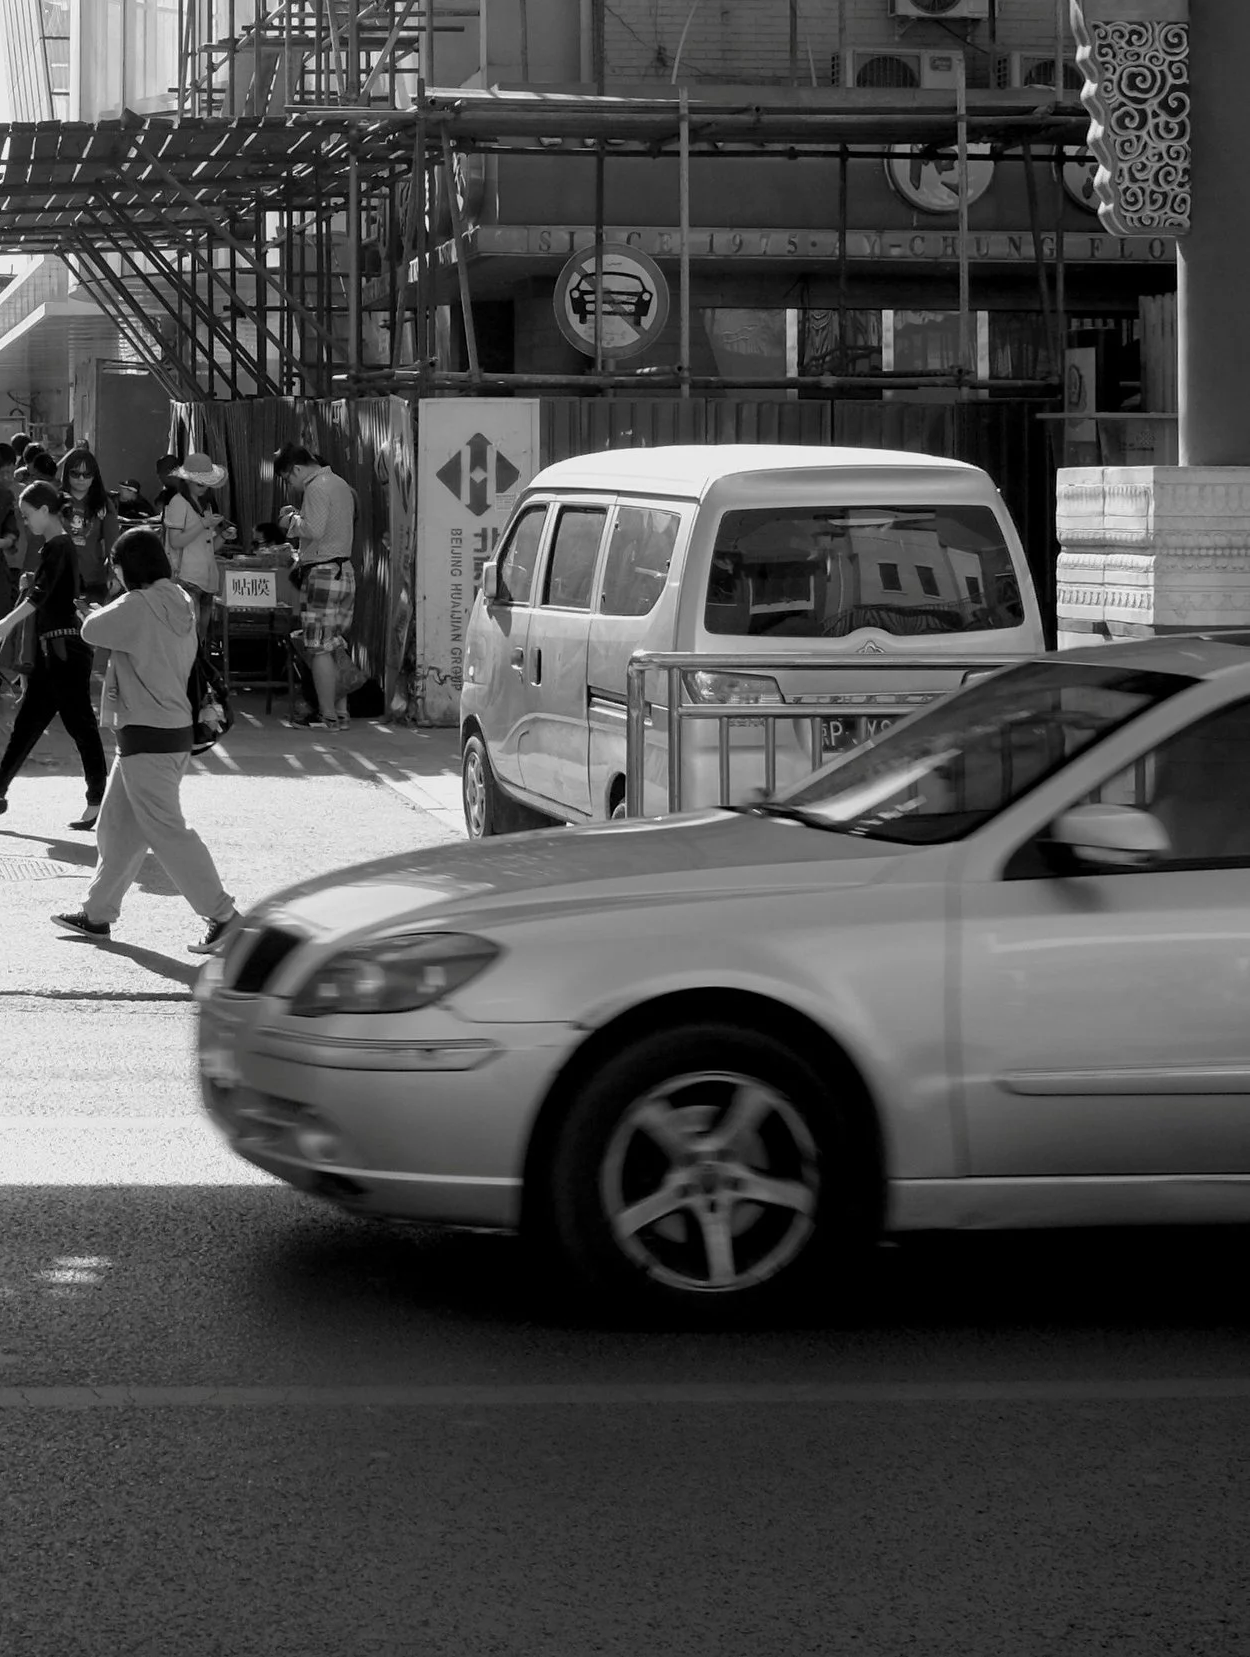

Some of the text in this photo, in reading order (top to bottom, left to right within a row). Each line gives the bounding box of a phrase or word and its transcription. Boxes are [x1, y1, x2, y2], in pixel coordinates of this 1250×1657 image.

[539, 231, 672, 254] SICE
[231, 578, 270, 596] 贴膜
[451, 528, 463, 691] BEIJING HUAIJIAN GROUP
